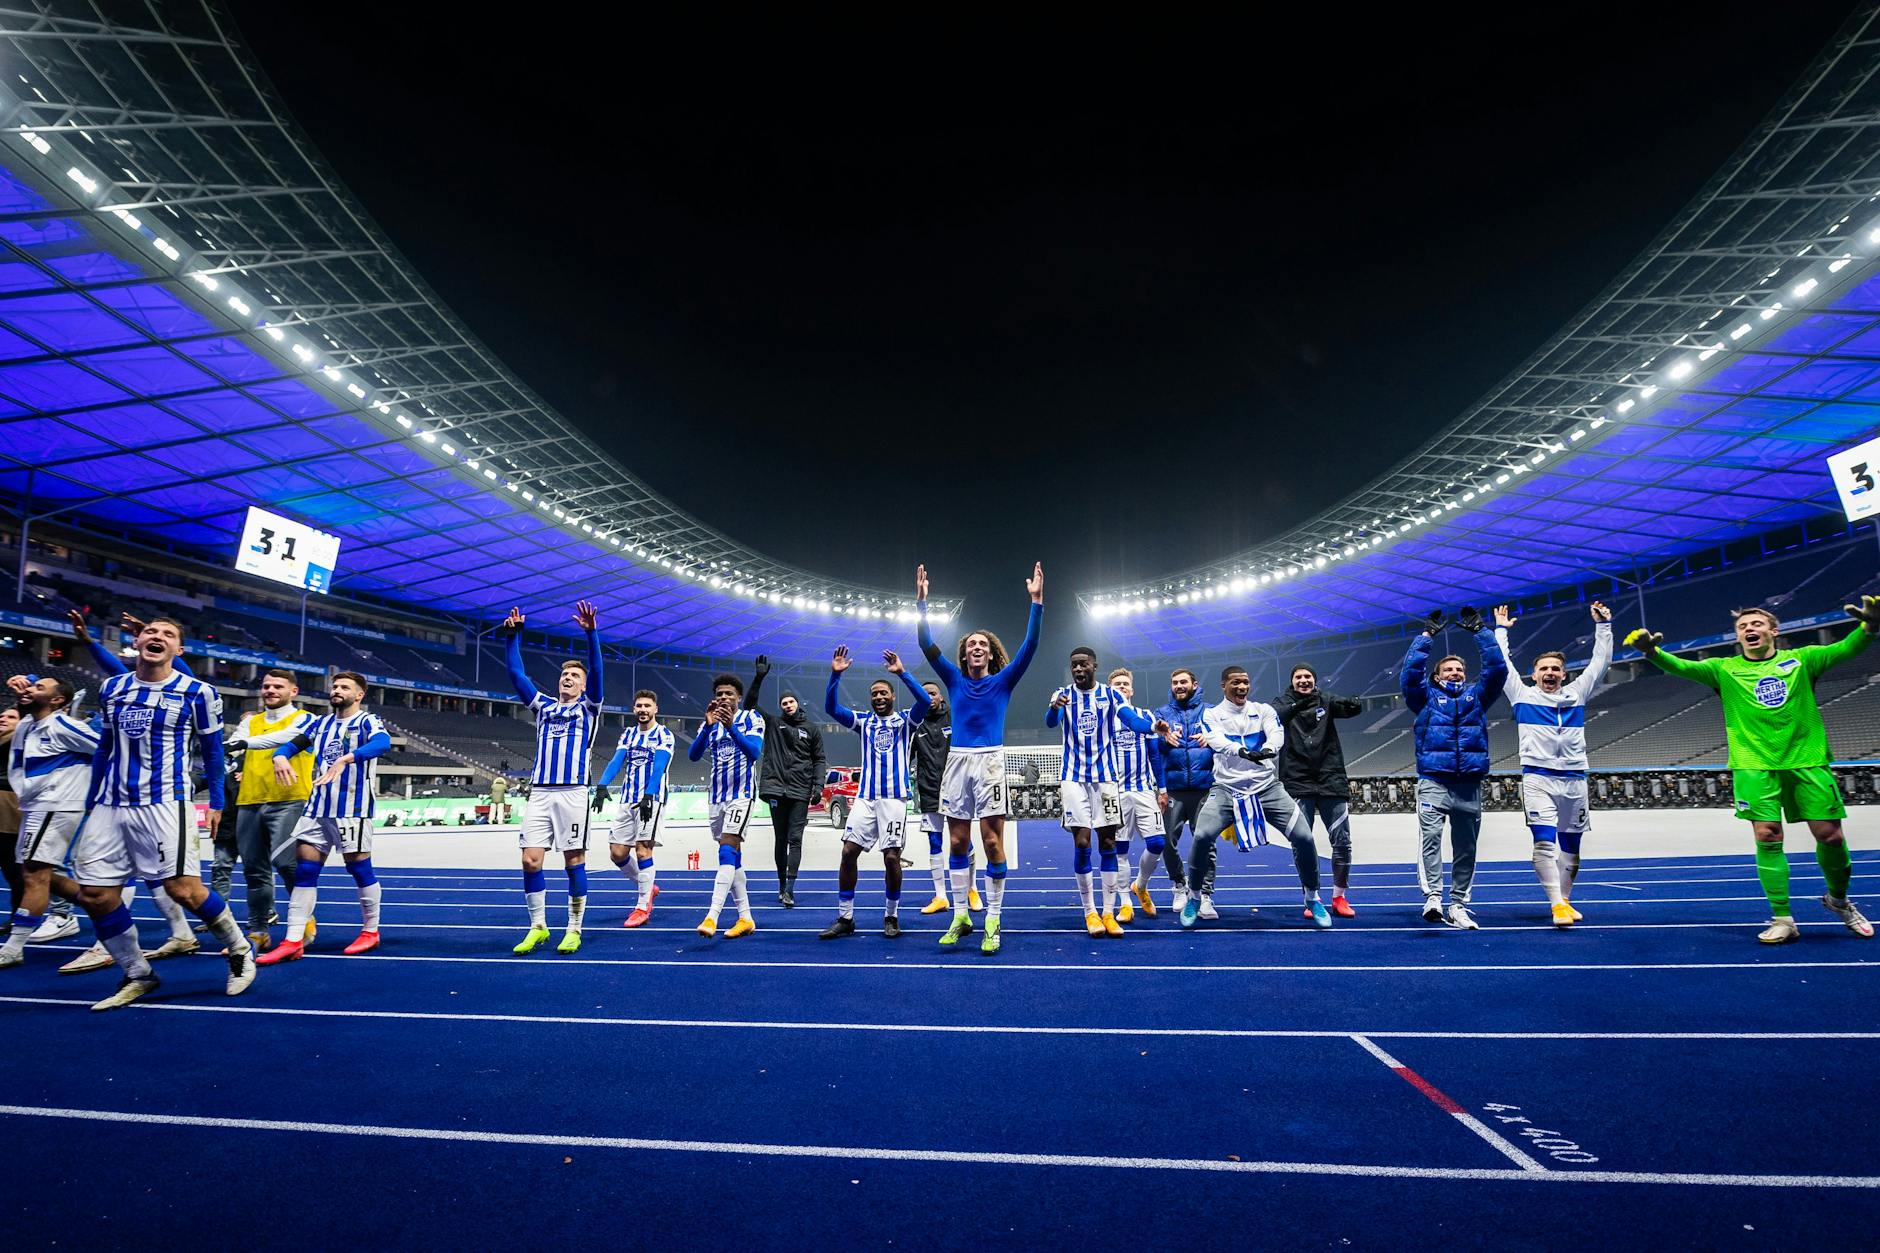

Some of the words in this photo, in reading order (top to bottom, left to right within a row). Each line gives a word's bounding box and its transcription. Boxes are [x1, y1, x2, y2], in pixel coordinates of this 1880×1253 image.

[281, 537, 297, 560] 1
[1755, 681, 1786, 695] HERTHA
[1758, 689, 1787, 702] KNEIPE
[119, 708, 153, 721] HERTHA
[119, 719, 151, 730] KNEIPE
[993, 785, 1001, 801] 8
[1829, 784, 1838, 801] 1
[1103, 799, 1118, 814] 25
[729, 809, 742, 823] 16
[1579, 808, 1585, 823] 2
[339, 826, 355, 842] 21
[571, 823, 579, 839] 9
[886, 821, 901, 836] 42
[157, 842, 165, 863] 5
